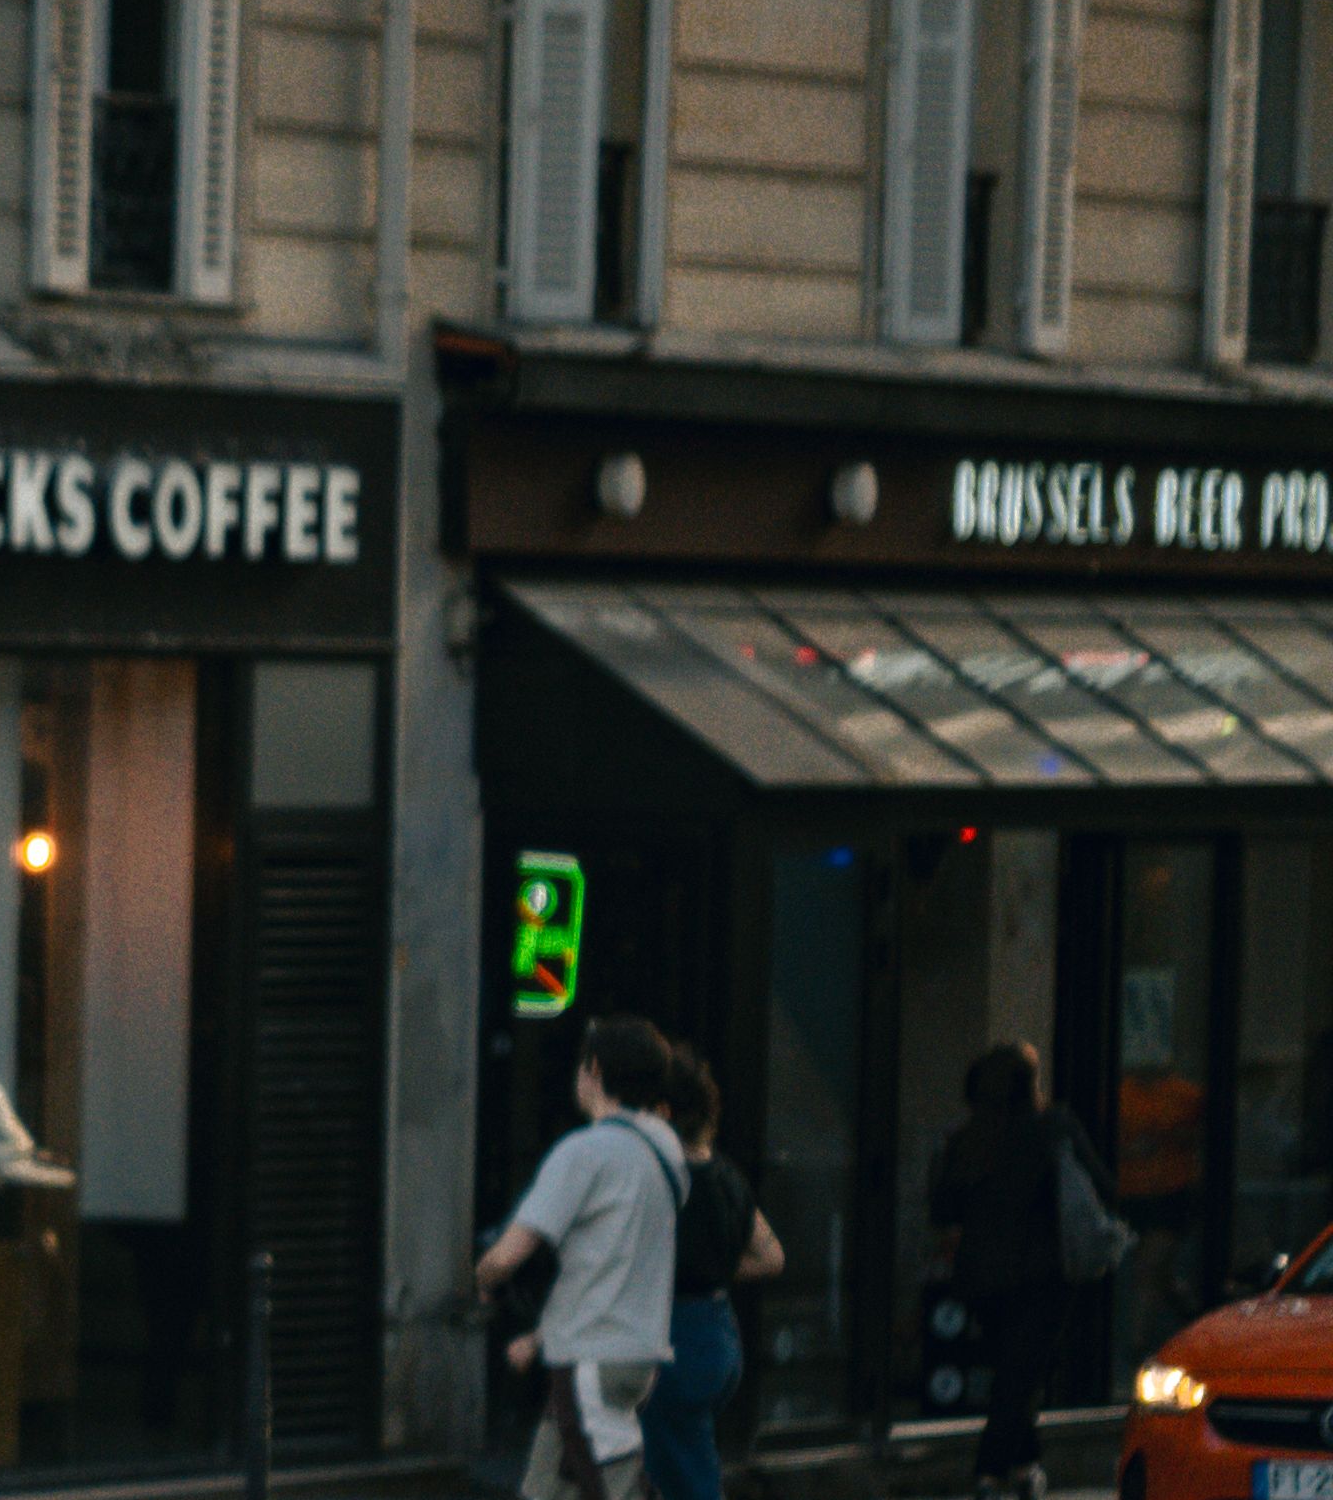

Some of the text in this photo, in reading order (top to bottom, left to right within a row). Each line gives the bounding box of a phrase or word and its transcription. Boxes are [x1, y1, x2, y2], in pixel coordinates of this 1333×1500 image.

[106, 454, 362, 564] COFFEE
[951, 456, 1137, 547] BRUSSELS
[1153, 465, 1246, 554] BEER
